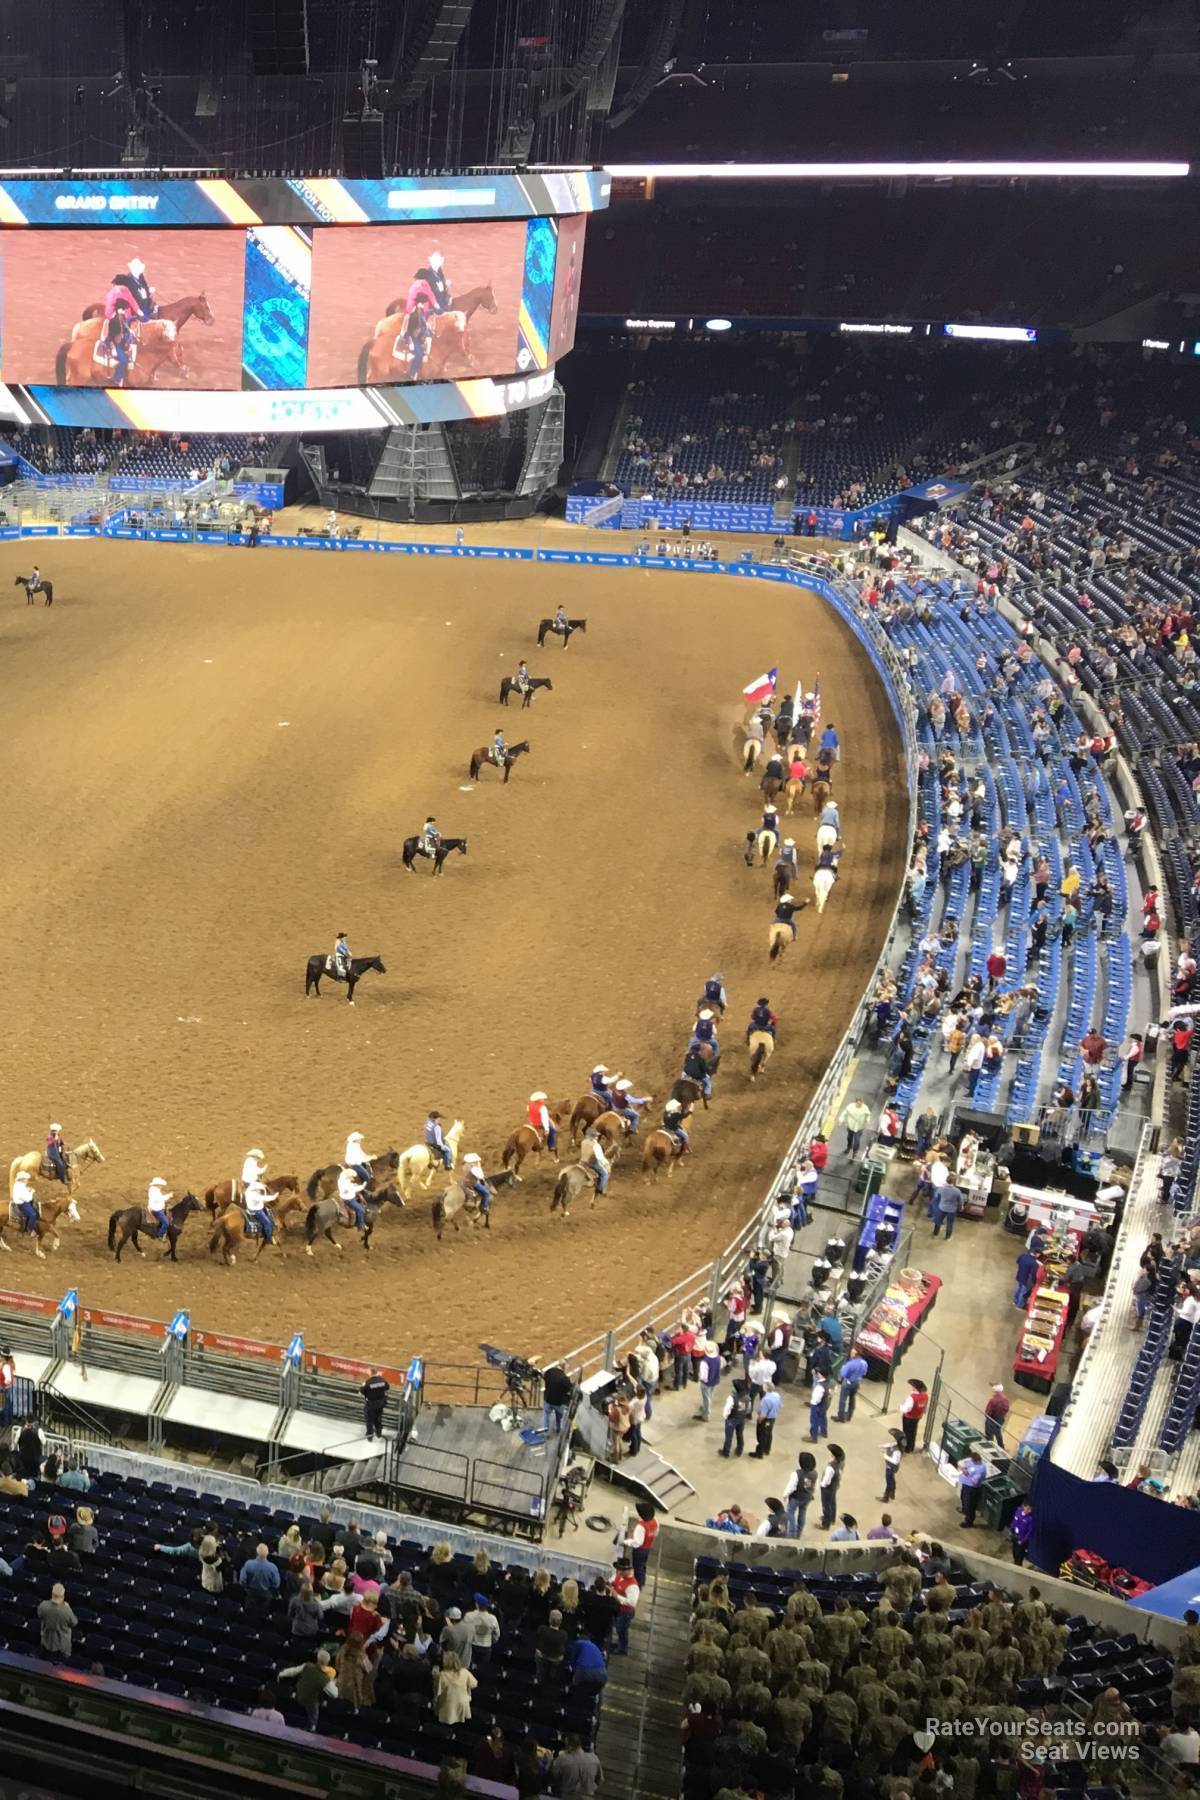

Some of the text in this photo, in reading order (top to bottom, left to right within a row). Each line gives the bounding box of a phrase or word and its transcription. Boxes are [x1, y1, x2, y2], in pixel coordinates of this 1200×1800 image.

[55, 195, 159, 210] GRAND ENTRY
[83, 1310, 91, 1321] 3
[196, 1333, 204, 1344] 2
